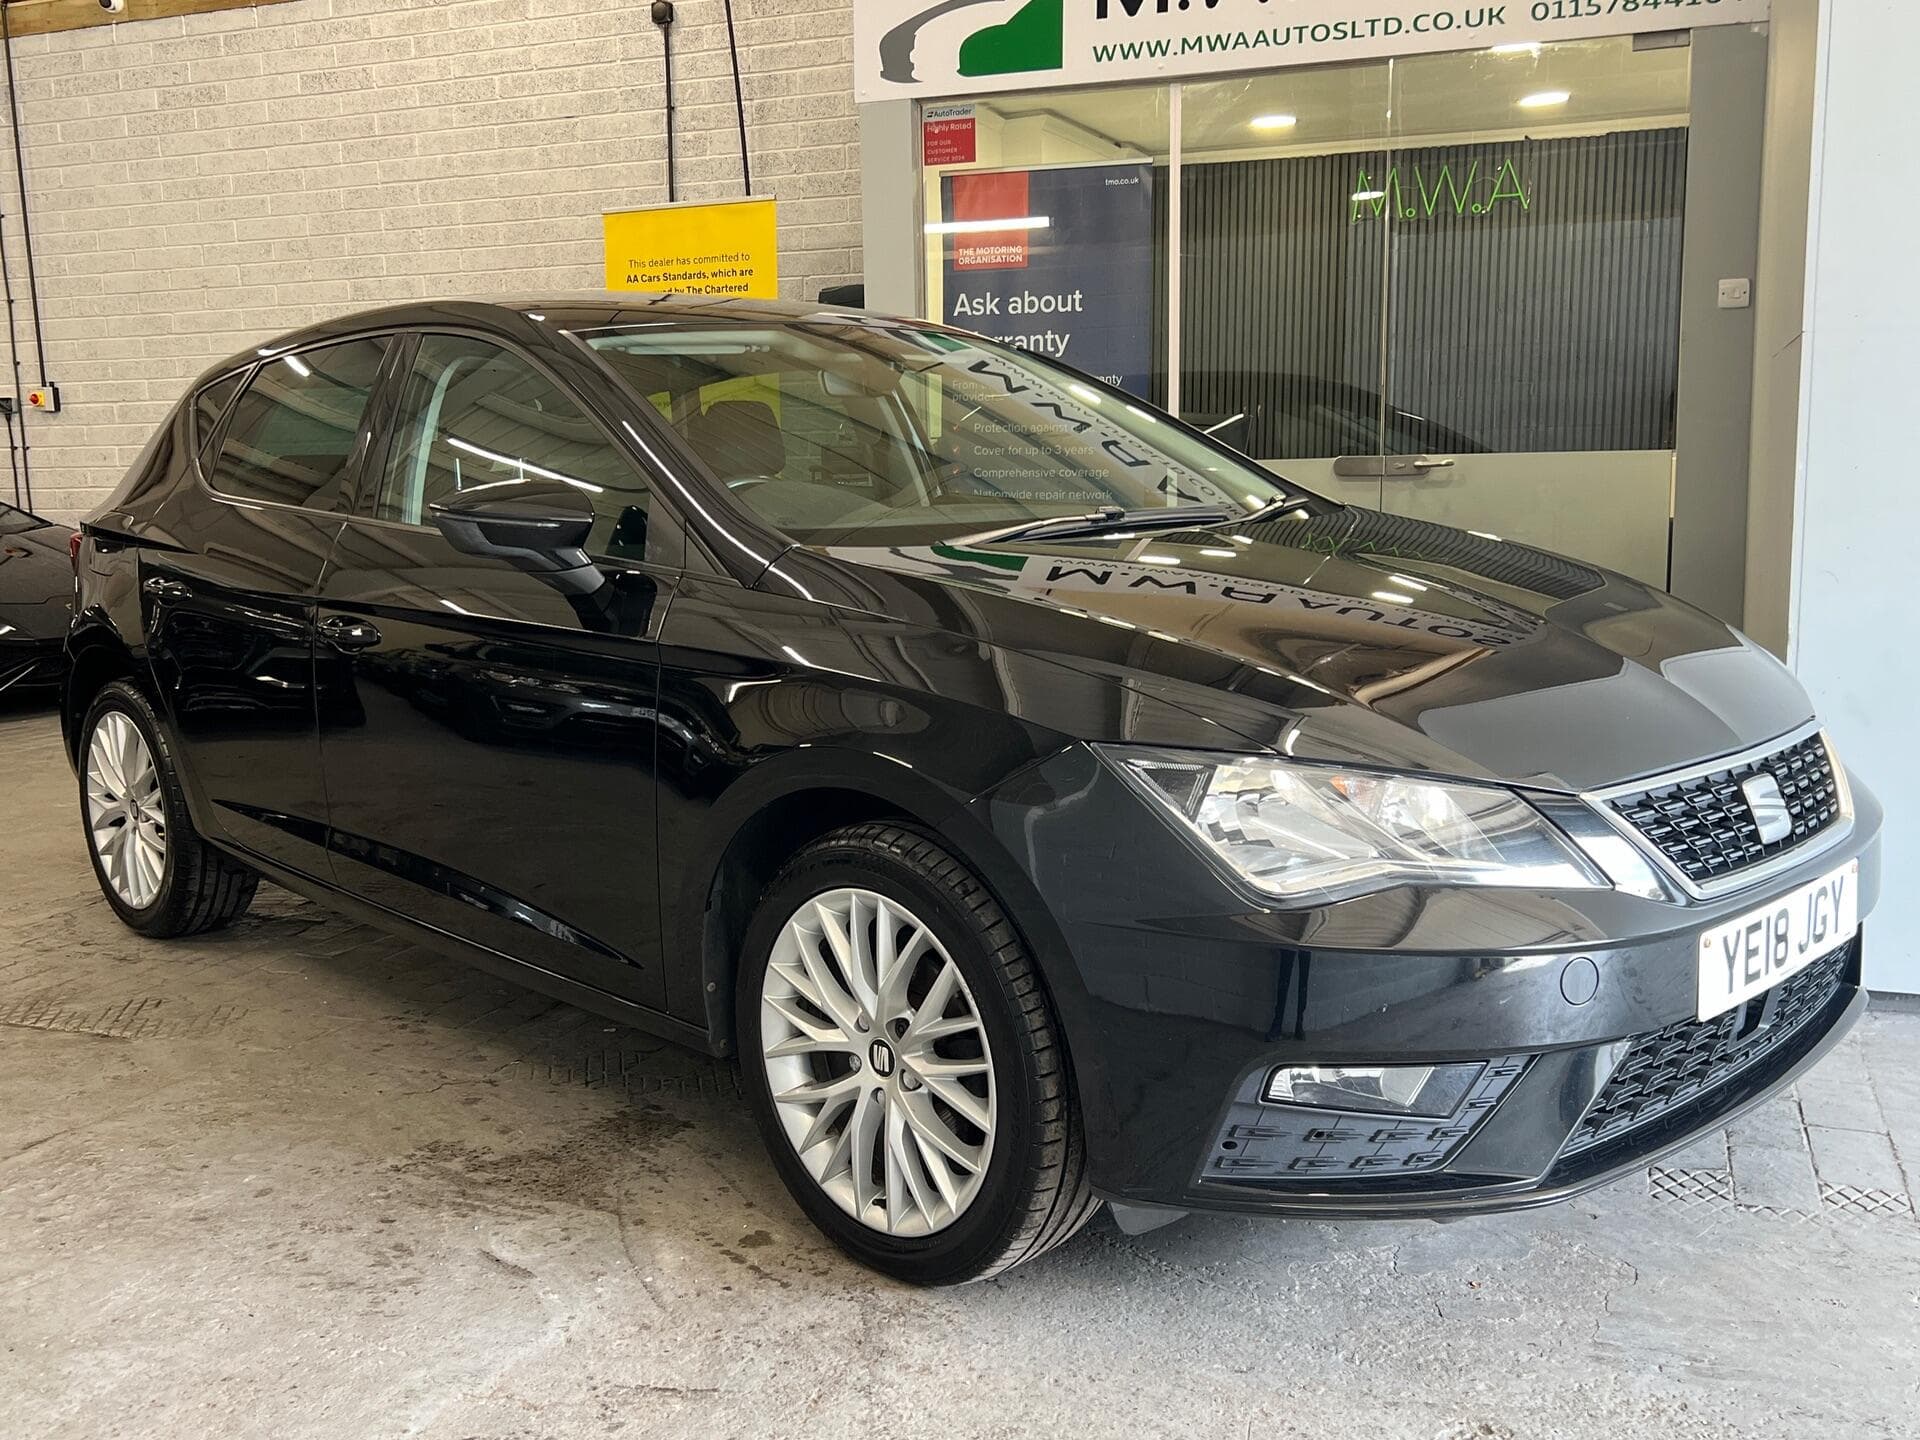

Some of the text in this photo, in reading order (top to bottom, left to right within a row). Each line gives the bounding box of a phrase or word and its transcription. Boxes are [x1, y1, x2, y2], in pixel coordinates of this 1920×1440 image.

[1093, 6, 1506, 63] WWW.MWAAUTOSLTD.CO.UK
[934, 108, 972, 118] AutoTrader
[950, 122, 972, 130] Rated
[1105, 177, 1140, 186] tmo.co.uk
[1352, 158, 1528, 223] M.W.A
[959, 245, 1023, 256] THE MOTORING
[629, 252, 751, 269] This dealer has committed to
[958, 254, 1023, 265] ORGANISATION
[626, 268, 754, 284] AA Cars Standards, which are
[686, 286, 703, 295] The
[704, 283, 749, 294] Chartered
[953, 290, 1083, 317] Ask about
[974, 423, 1028, 433] Protection
[973, 445, 1095, 457] Cover for up to 3 years
[973, 467, 1110, 479] Comprehensive coverage
[973, 488, 1113, 501] Nationwide repair network
[1722, 875, 1845, 994] YE18 JGY
